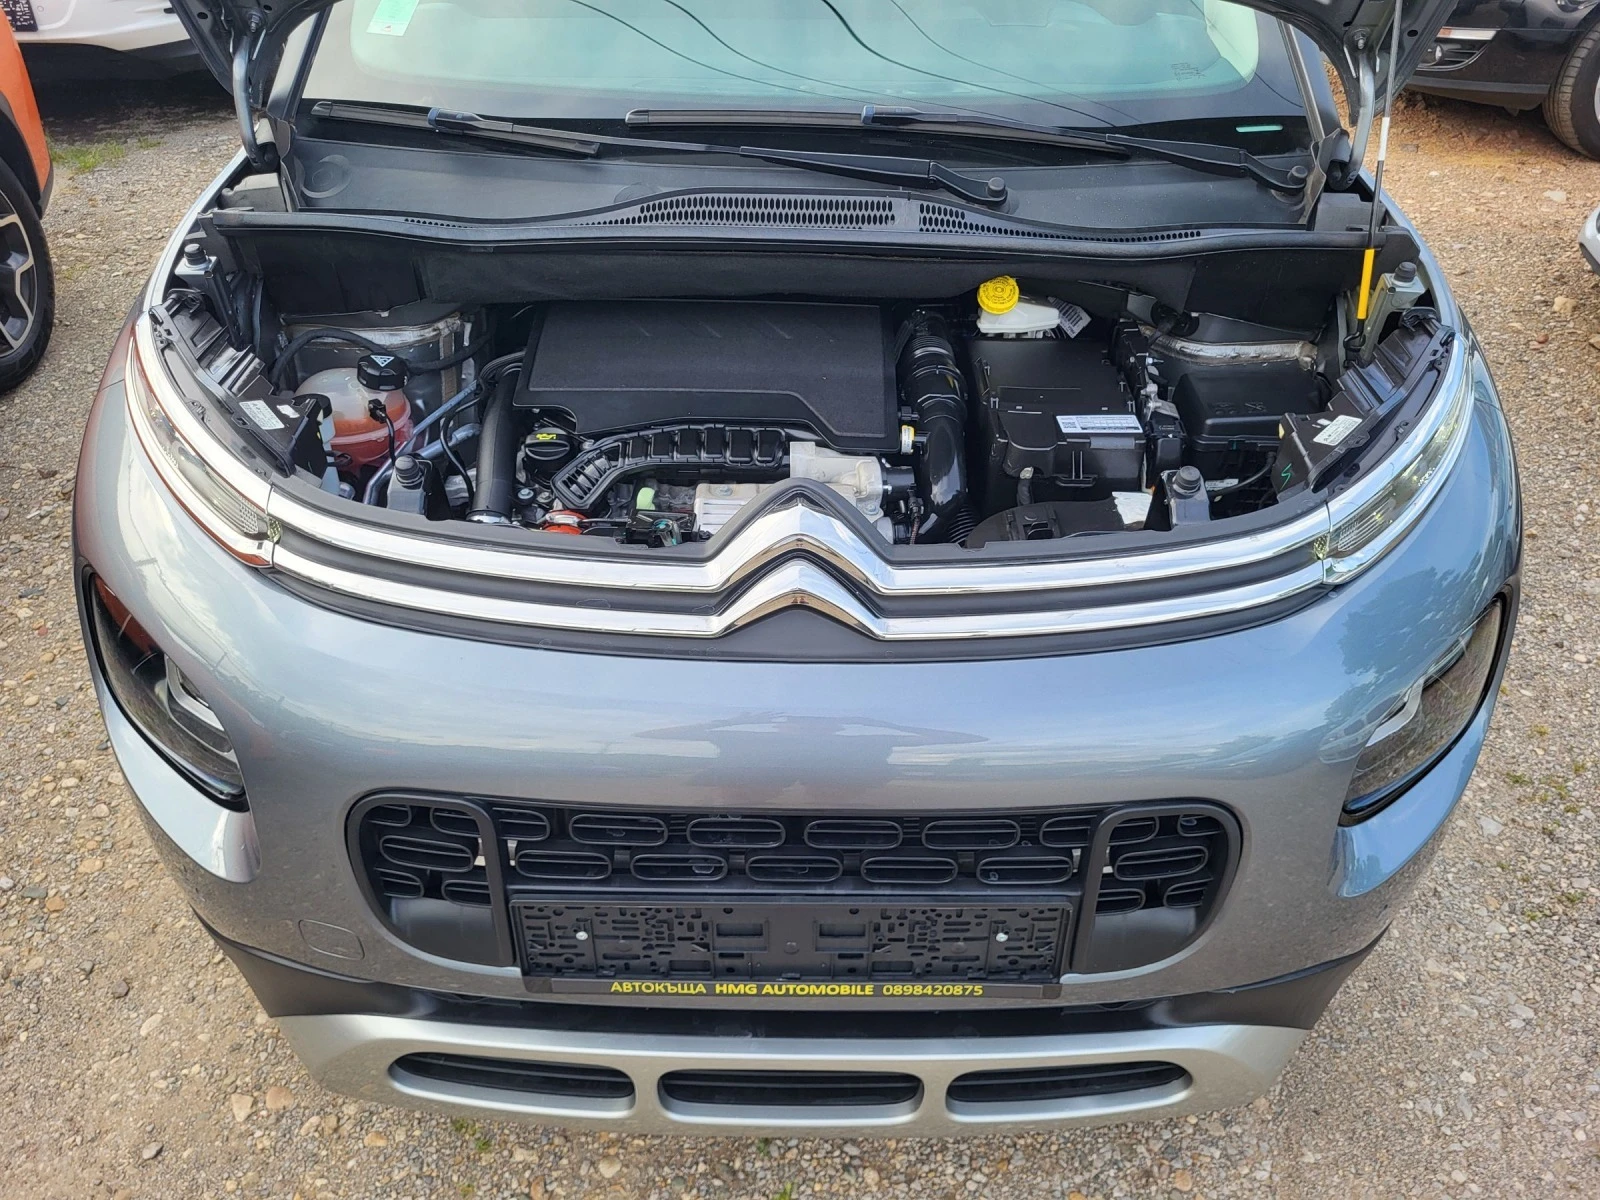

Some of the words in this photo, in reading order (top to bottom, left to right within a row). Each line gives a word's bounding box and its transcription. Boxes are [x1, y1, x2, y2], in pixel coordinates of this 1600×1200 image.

[610, 981, 706, 995] АВТОКЪЩА
[715, 983, 758, 995] HMG
[761, 984, 874, 996] AUTOMOBILE
[882, 984, 984, 996] 0898420875
